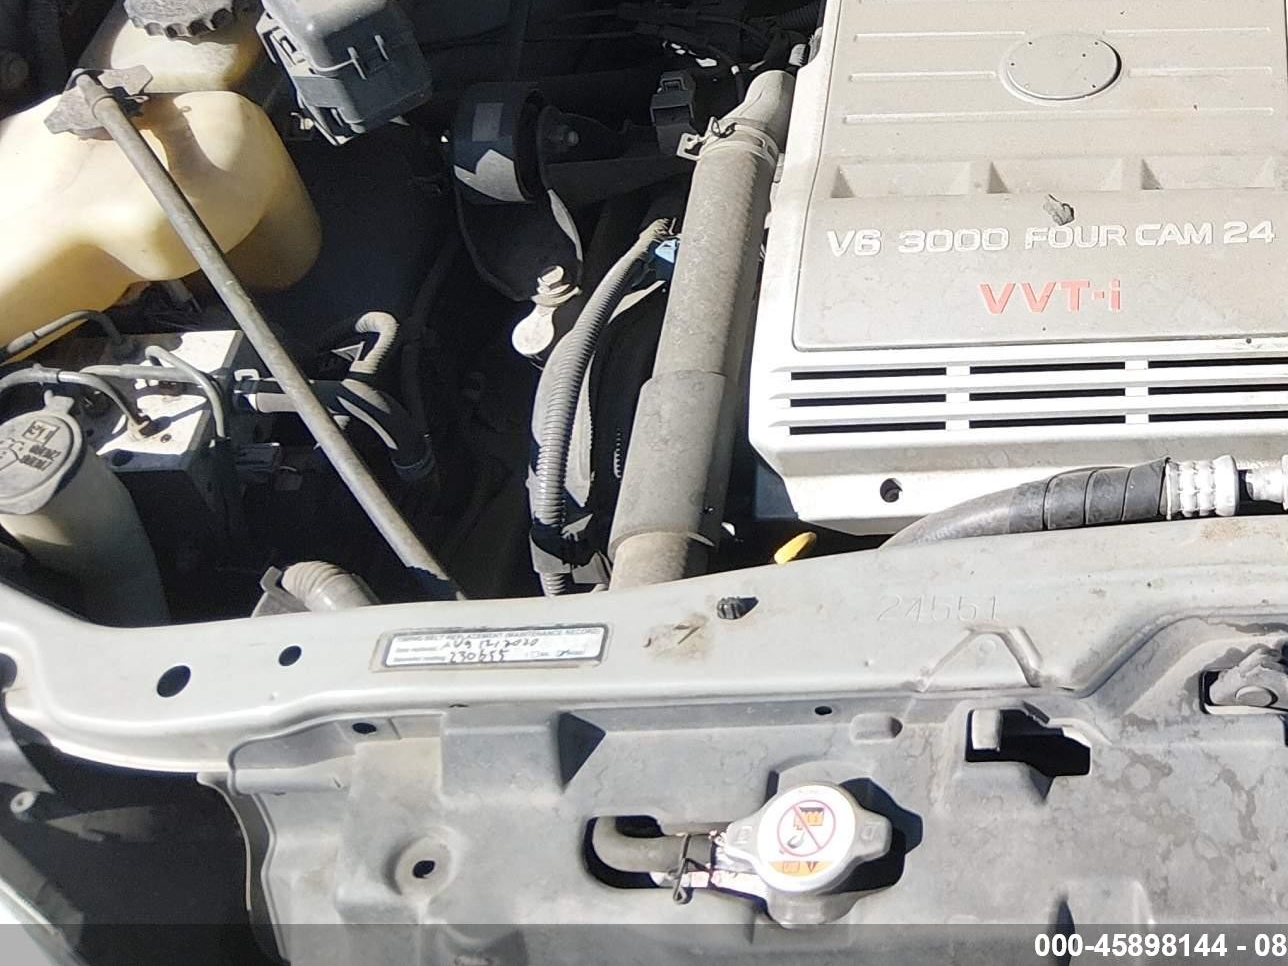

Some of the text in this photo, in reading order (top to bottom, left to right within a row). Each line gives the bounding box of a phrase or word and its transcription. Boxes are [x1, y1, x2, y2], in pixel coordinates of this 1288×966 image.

[827, 220, 1275, 256] V6 3000 FOUR CAM 24
[978, 279, 1122, 314] VVT-i
